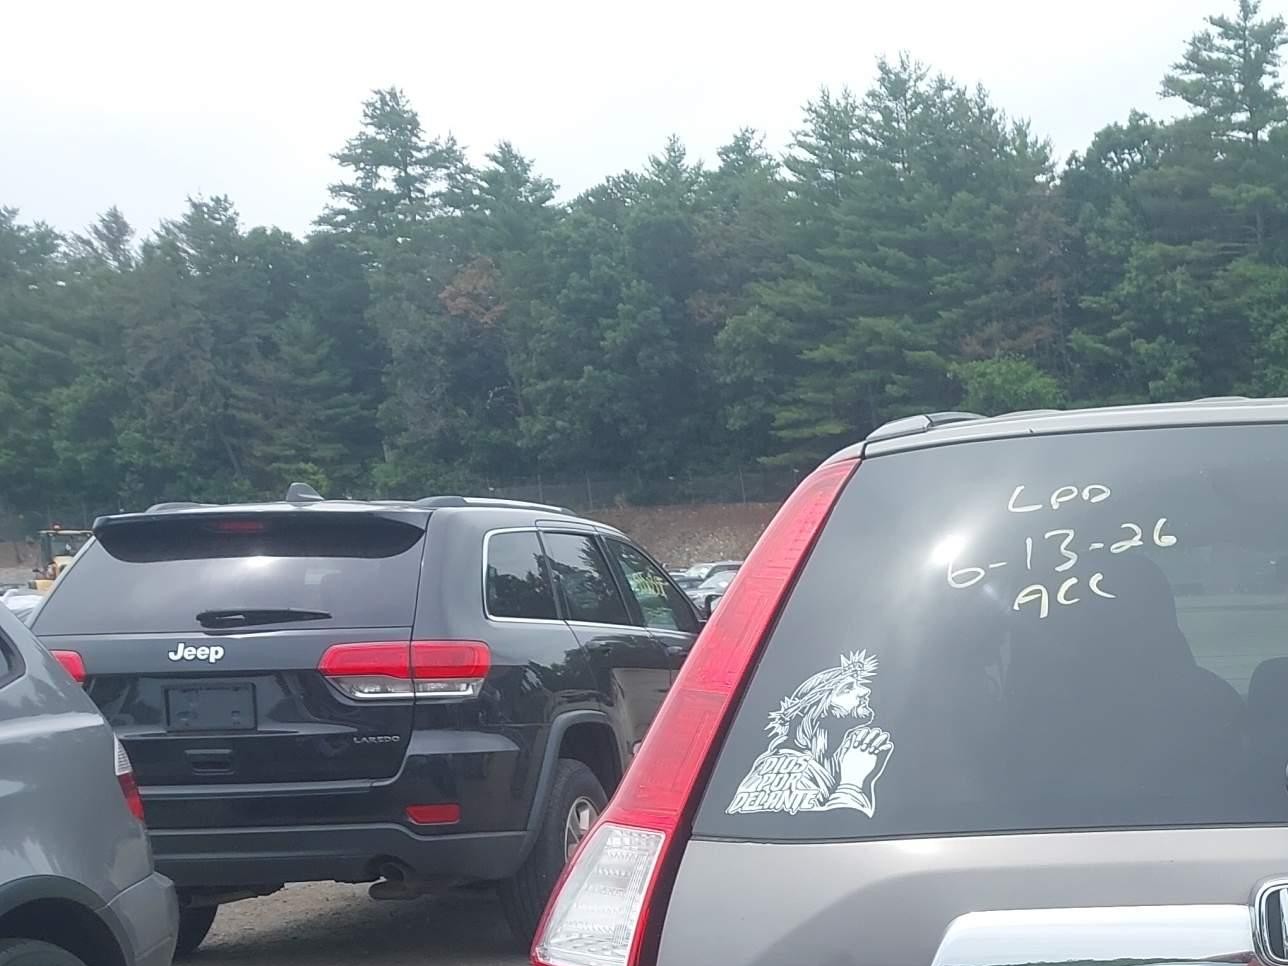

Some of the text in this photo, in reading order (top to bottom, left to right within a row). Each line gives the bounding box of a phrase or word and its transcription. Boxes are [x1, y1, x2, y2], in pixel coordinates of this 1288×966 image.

[168, 642, 225, 664] Jeep
[352, 735, 401, 744] LAREDO
[759, 756, 808, 774] DIOS
[756, 773, 802, 791] POR
[729, 789, 817, 814] DELANTE
